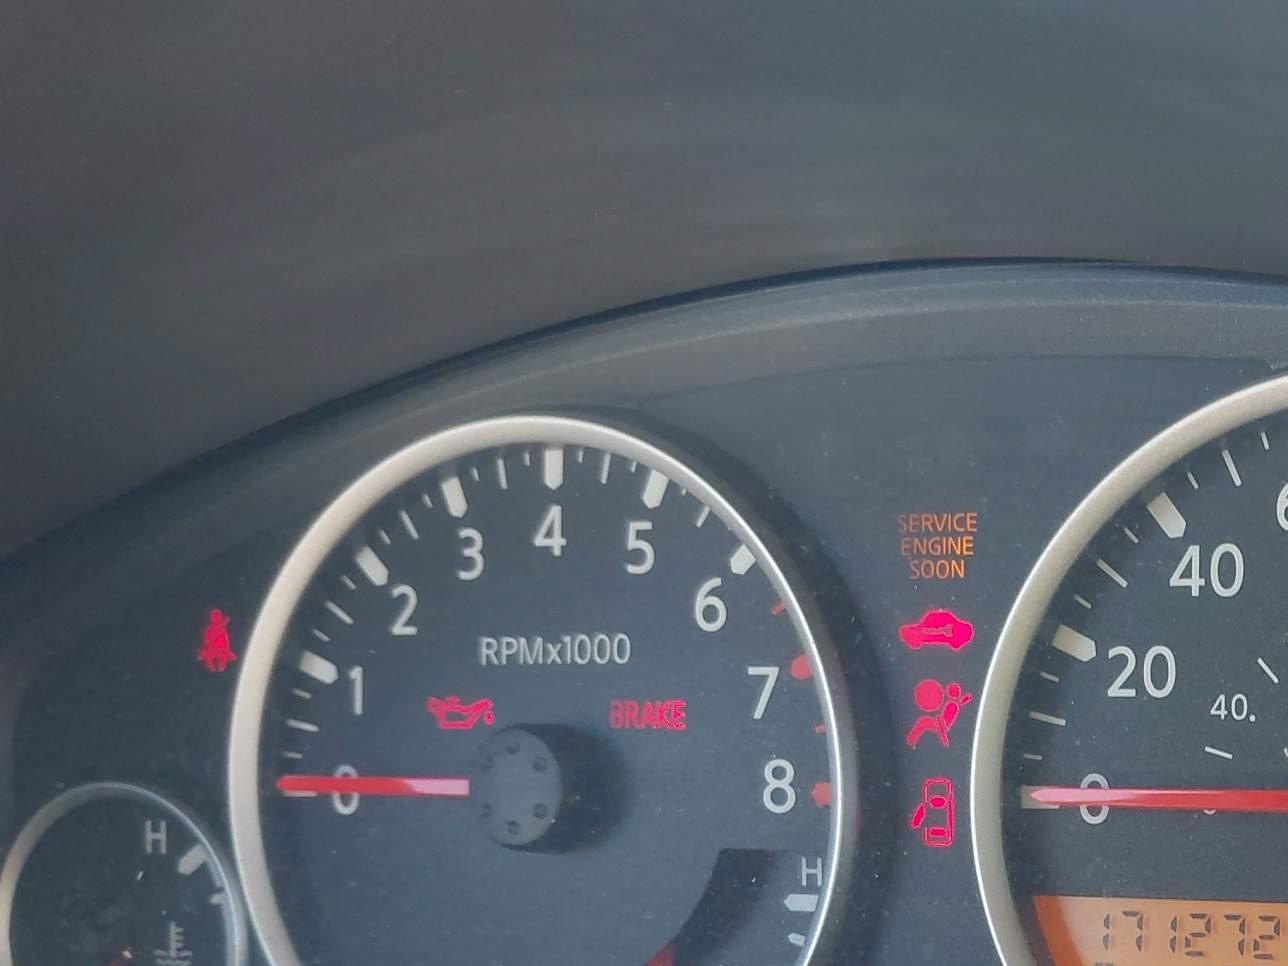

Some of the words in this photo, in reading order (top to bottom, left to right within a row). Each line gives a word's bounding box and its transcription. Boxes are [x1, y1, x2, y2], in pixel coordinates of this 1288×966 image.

[533, 504, 567, 557] 4
[898, 512, 977, 532] SERVICE
[901, 536, 974, 556] ENGINE
[458, 528, 484, 581] 3
[626, 521, 655, 575] 5
[910, 560, 965, 579] SOON
[1169, 542, 1244, 597] 40
[391, 584, 418, 636] 2
[694, 577, 727, 632] 6
[480, 633, 632, 666] RPMx1000
[1107, 645, 1176, 699] 20
[348, 666, 365, 717] 1
[609, 699, 687, 731] BRAKE
[747, 666, 780, 720] 7
[1210, 693, 1248, 721] 40
[333, 765, 360, 815] 0
[762, 758, 796, 814] 8
[1079, 773, 1110, 824] 0
[144, 820, 167, 855] H
[801, 857, 823, 887] H
[1102, 910, 1281, 960] 171272
